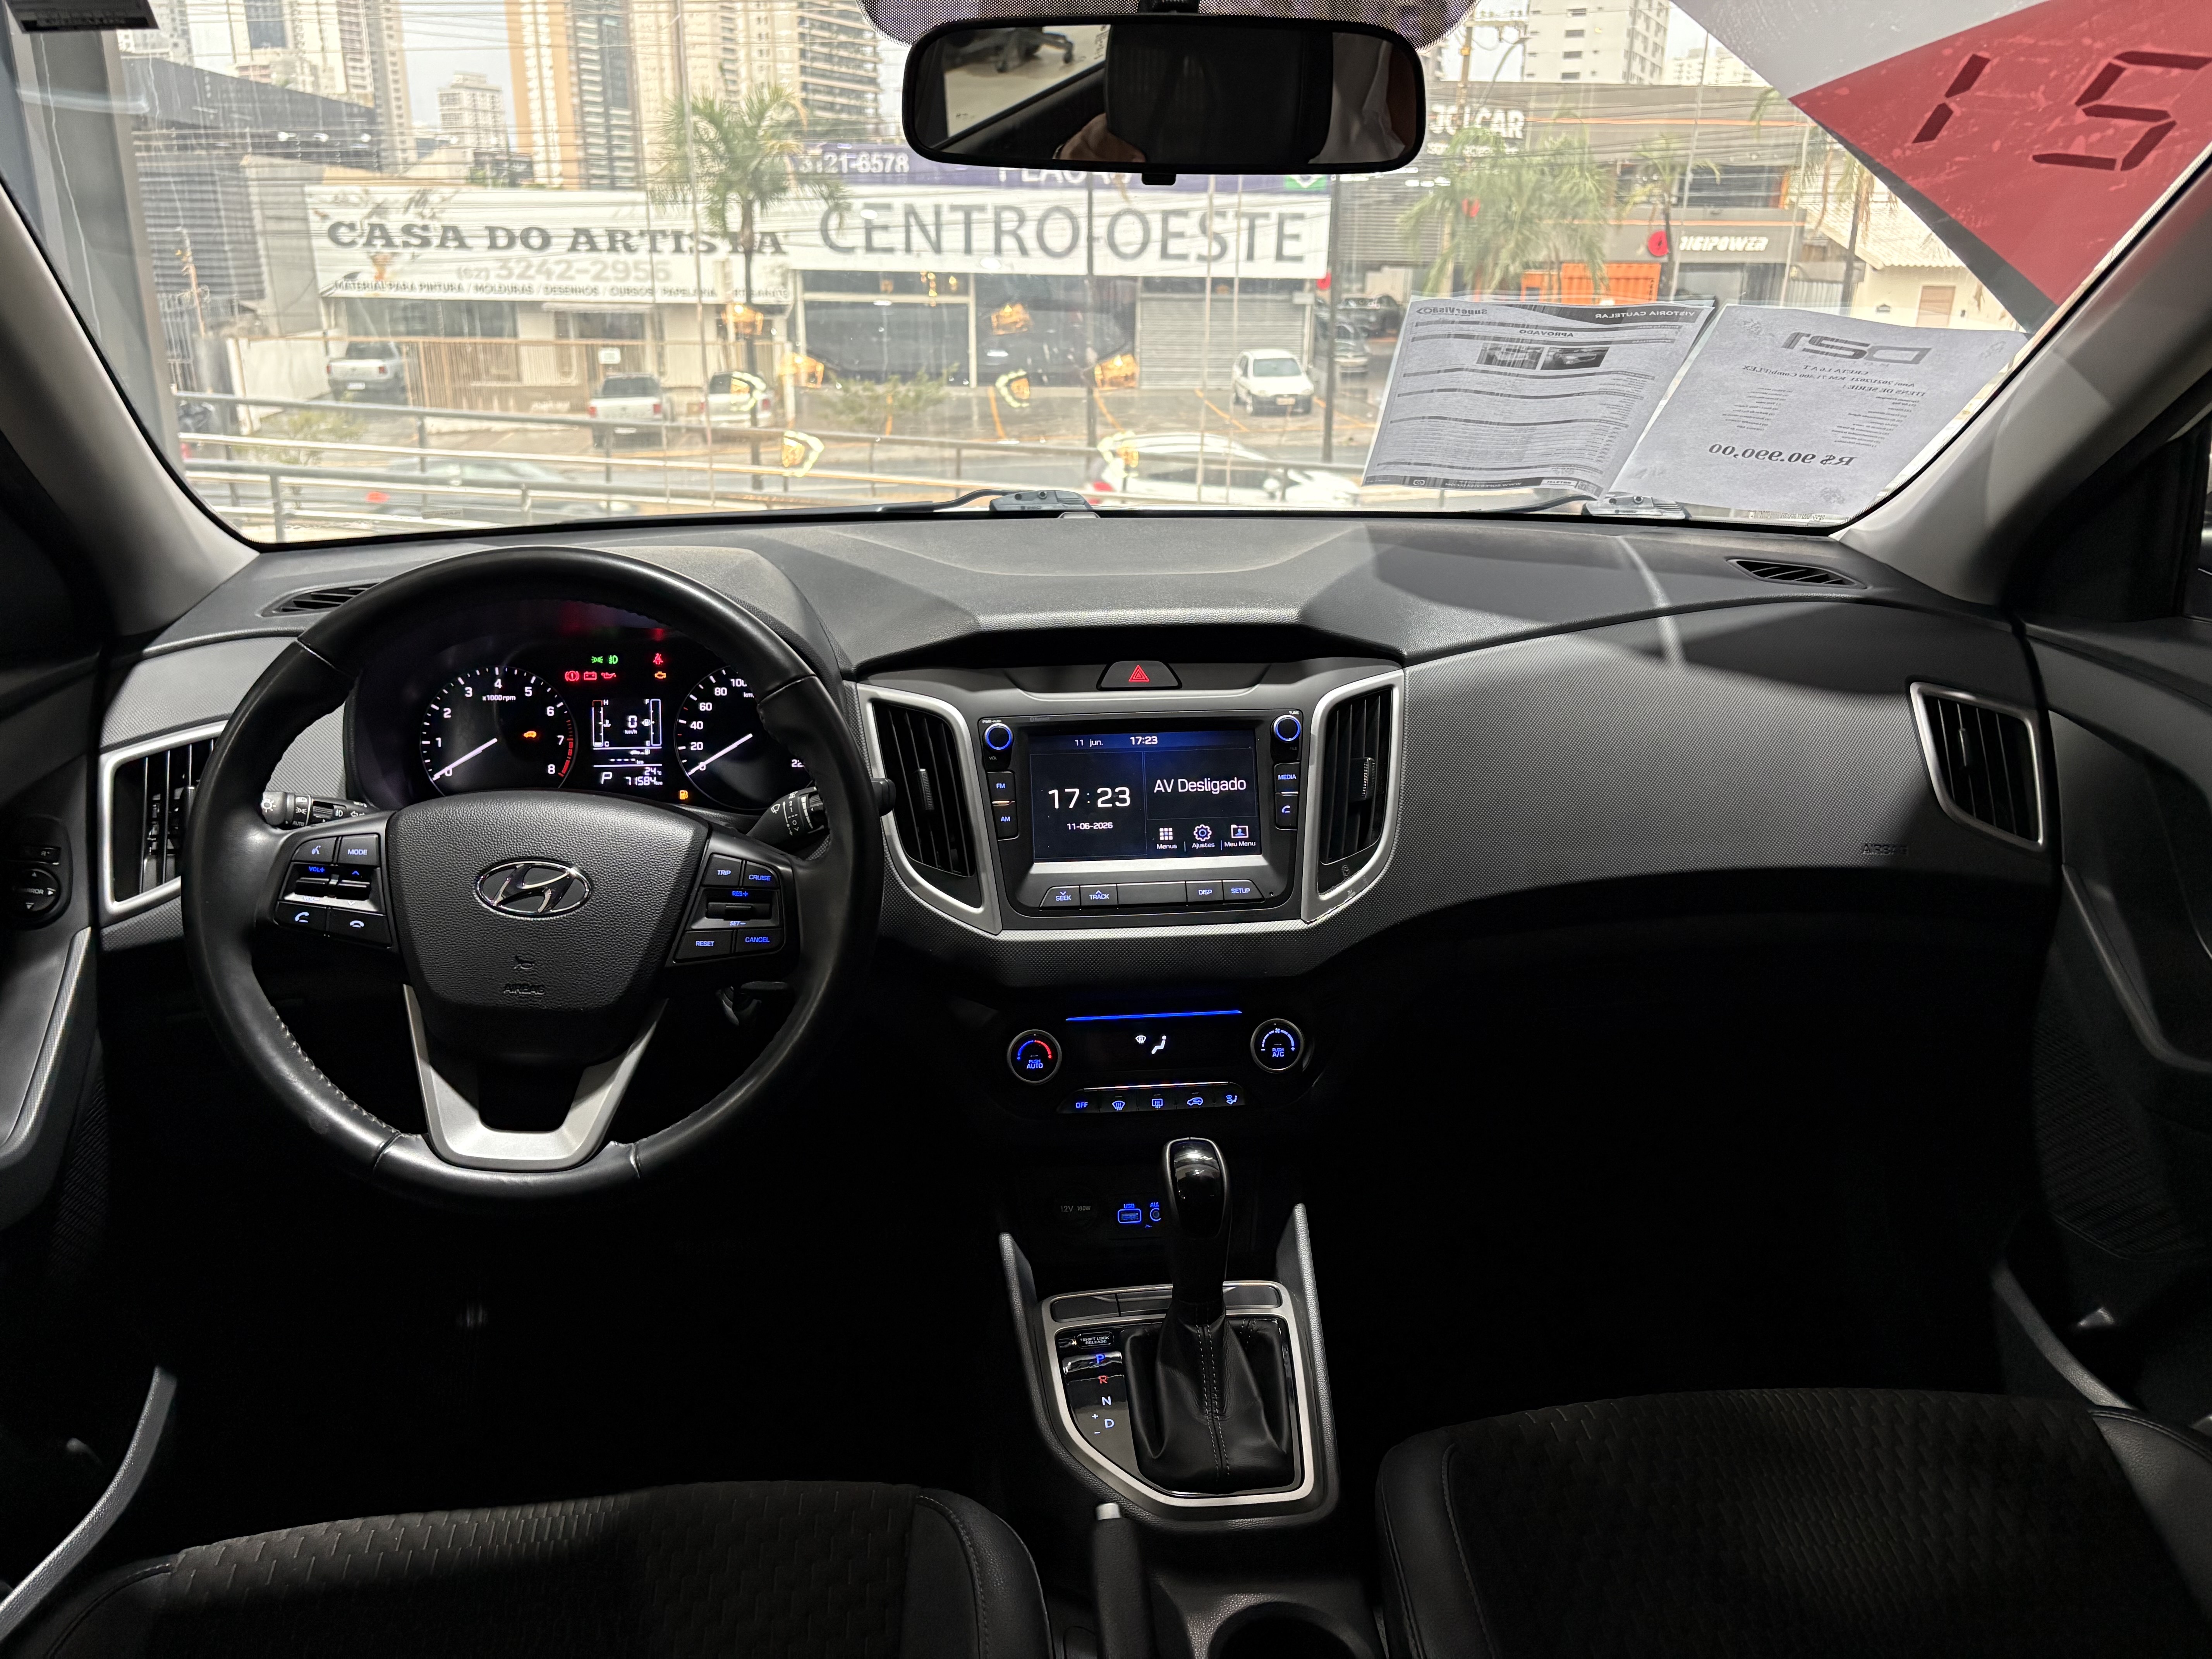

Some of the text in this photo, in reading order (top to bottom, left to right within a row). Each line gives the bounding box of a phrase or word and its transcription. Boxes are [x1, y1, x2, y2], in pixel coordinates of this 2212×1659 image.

[328, 222, 473, 249] CASA
[485, 225, 551, 251] DO
[494, 678, 502, 689] 4
[465, 687, 472, 697] 3
[524, 687, 532, 697] 5
[715, 687, 727, 696] 80
[546, 706, 554, 716] 6
[699, 702, 713, 711] 60
[443, 708, 451, 718] 2
[628, 715, 637, 728] 0
[690, 721, 703, 730] 40
[435, 737, 441, 747] 1
[557, 735, 564, 745] 7
[1075, 738, 1104, 747] 11 jun.
[1130, 736, 1158, 745] 17:23
[690, 742, 703, 750] 20
[699, 762, 706, 771] 0
[792, 759, 804, 768] 22
[445, 766, 452, 776] 0
[548, 764, 555, 774] 8
[601, 771, 613, 784] P
[1154, 776, 1247, 793] AV Desligado
[1066, 822, 1113, 830] 11-06-2026
[504, 983, 544, 995] AIRBAG
[1095, 1354, 1106, 1364] P
[1099, 1375, 1108, 1384] R
[1102, 1396, 1111, 1406] N
[1104, 1419, 1115, 1428] D
